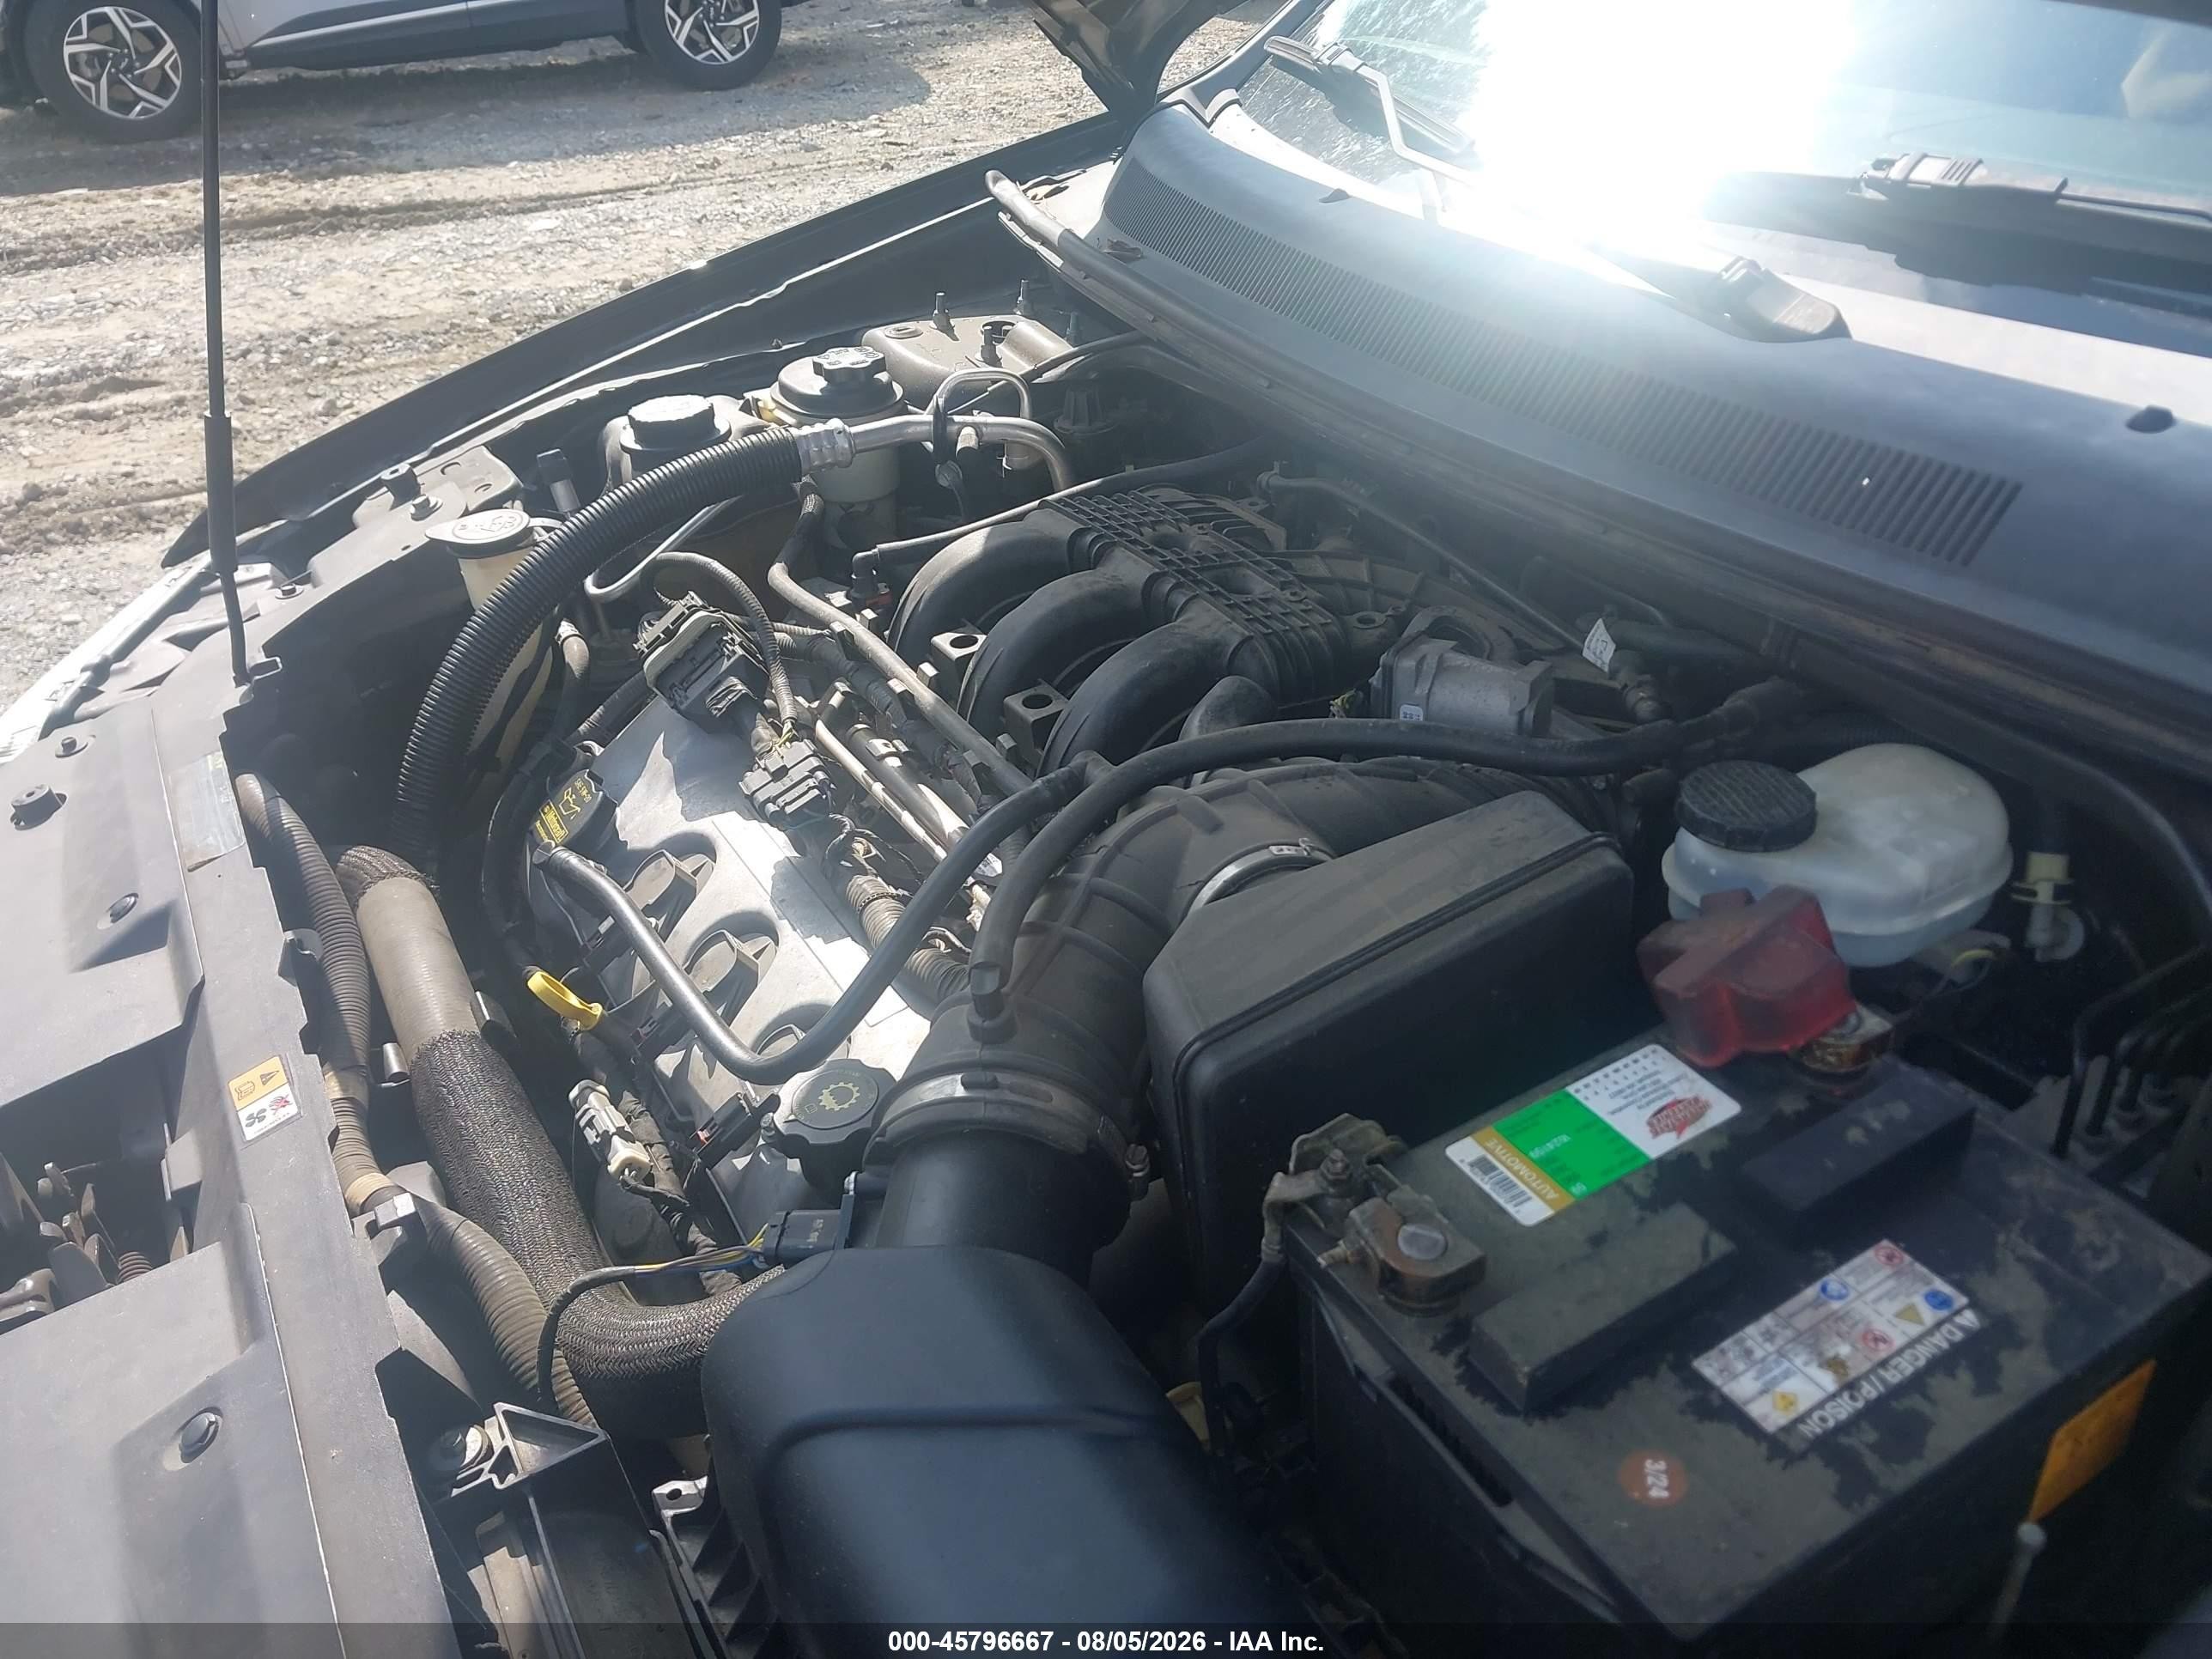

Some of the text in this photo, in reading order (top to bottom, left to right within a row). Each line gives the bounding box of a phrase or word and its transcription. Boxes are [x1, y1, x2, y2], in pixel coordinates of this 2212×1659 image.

[1486, 1139, 1560, 1200] AUTOMOTIVE
[1883, 1322, 1966, 1386] DANGER
[1644, 1459, 1669, 1498] 3/24
